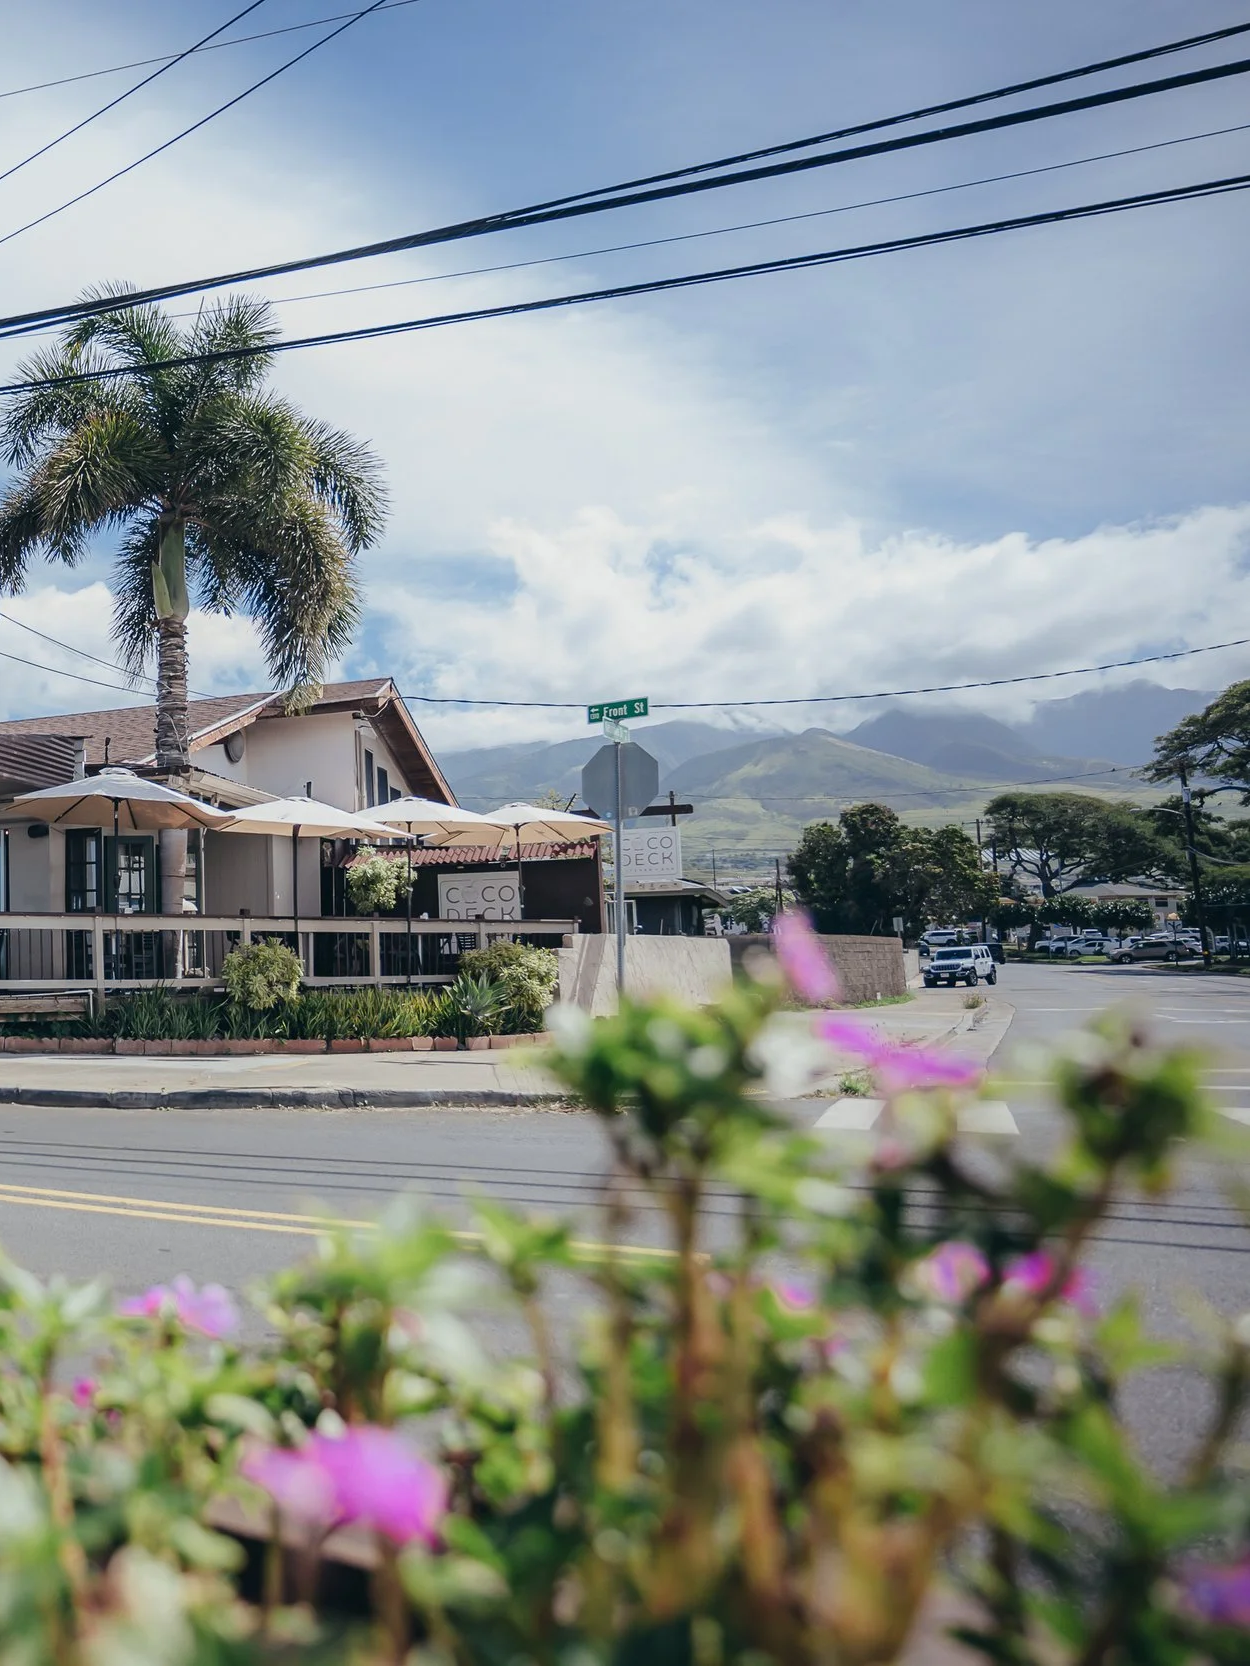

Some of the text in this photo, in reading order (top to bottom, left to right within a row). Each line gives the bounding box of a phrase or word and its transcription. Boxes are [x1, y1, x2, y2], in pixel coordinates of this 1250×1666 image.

[603, 704, 628, 717] Front
[634, 702, 645, 714] St
[622, 852, 674, 867] DECK
